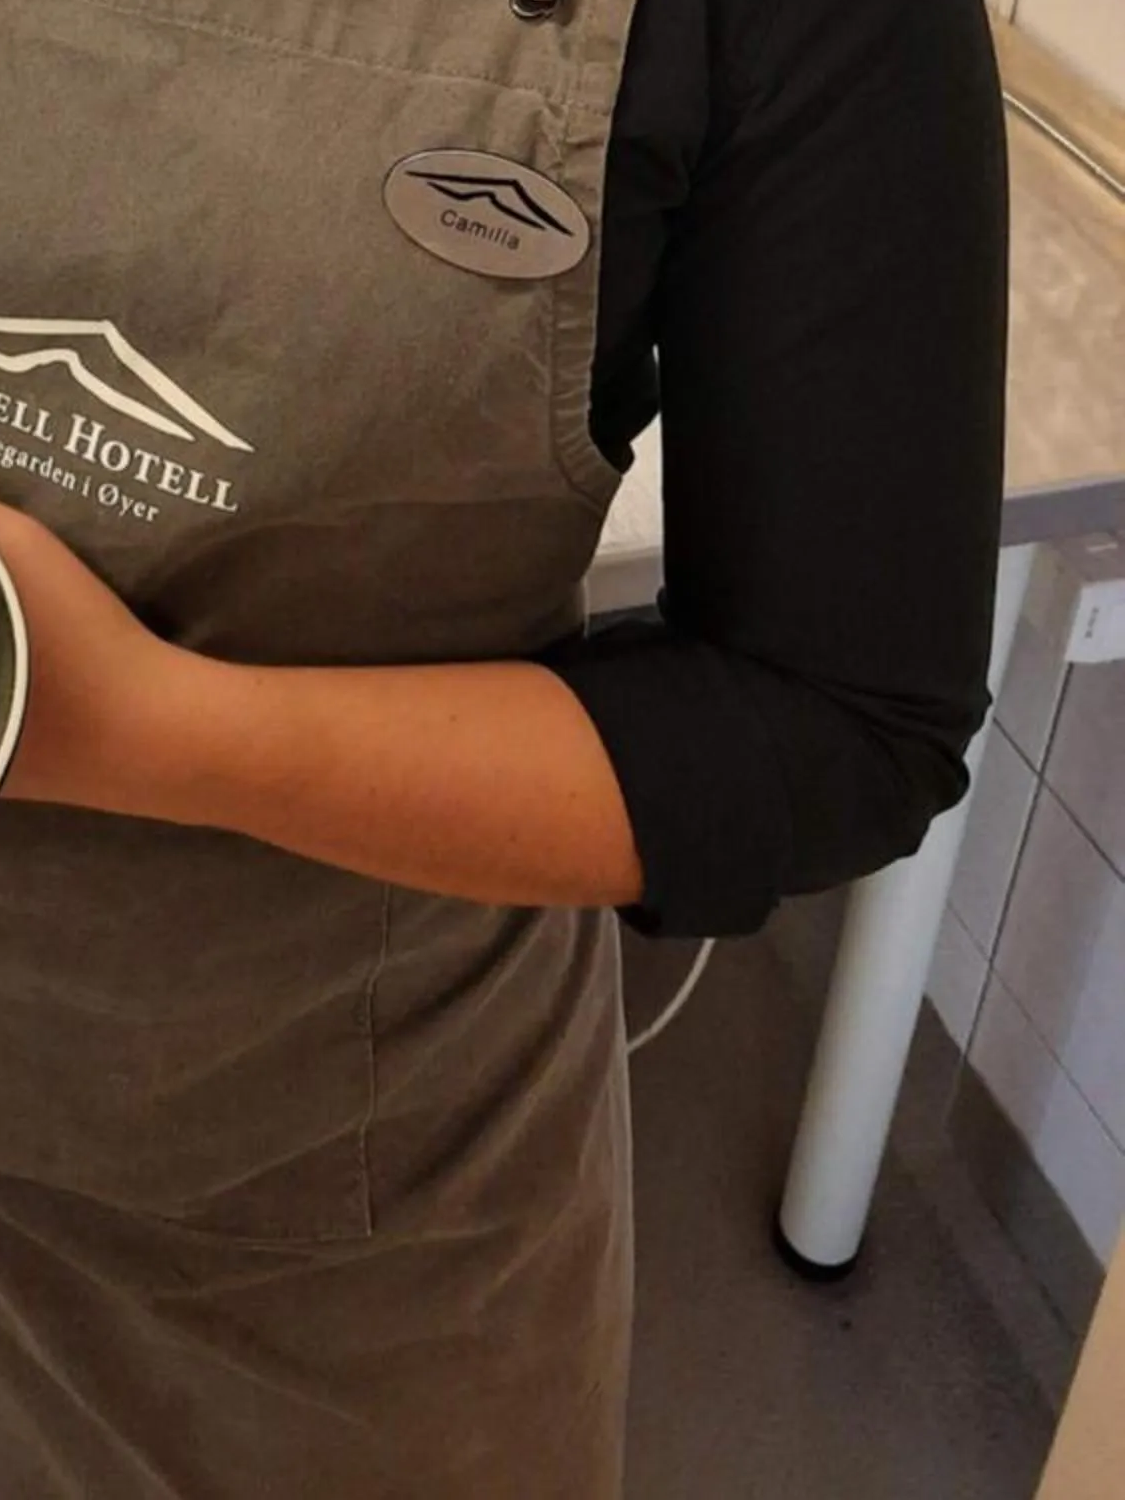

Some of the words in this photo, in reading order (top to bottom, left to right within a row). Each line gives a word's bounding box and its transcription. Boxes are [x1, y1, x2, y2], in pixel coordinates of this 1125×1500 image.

[440, 209, 520, 250] Camilla
[63, 413, 240, 513] HOTELL
[81, 477, 91, 496] i
[98, 482, 161, 524] Øyer
